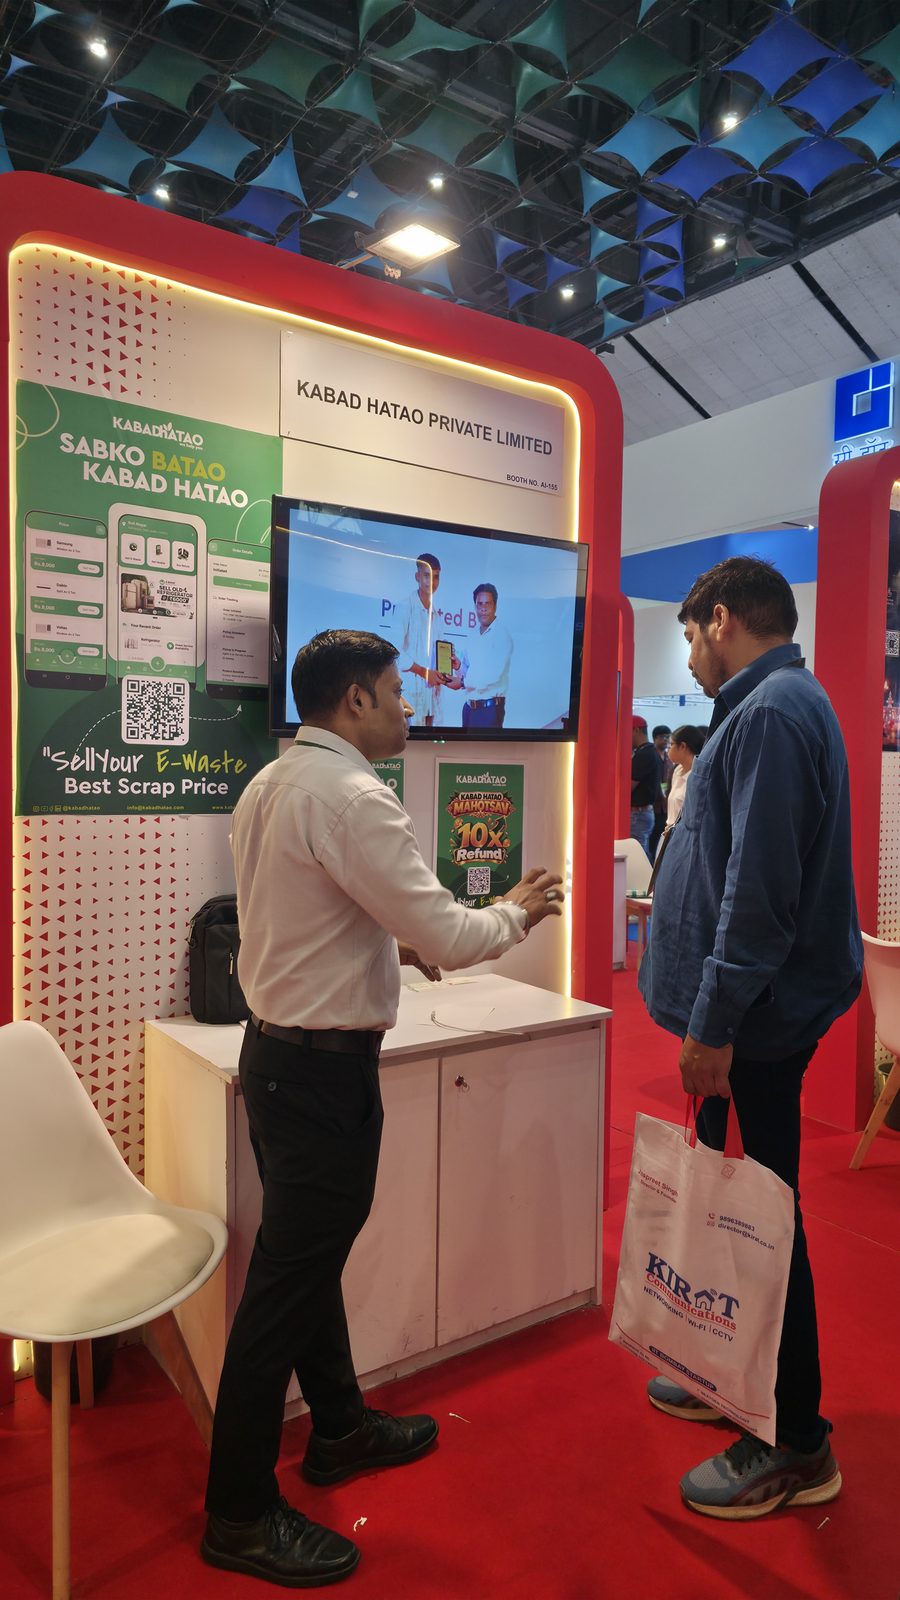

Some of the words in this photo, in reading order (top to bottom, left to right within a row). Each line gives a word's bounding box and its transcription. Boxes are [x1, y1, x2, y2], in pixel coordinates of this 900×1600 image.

[297, 379, 361, 410] KABAD
[367, 397, 423, 425] HATAO
[429, 412, 492, 442] PRIVATE
[497, 429, 552, 455] LIMITED
[60, 432, 145, 466] SABKO
[152, 451, 226, 482] BATAO
[83, 461, 167, 493] KABAD
[174, 478, 248, 508] HATAO
[506, 474, 528, 486] BOOTH
[529, 477, 539, 487] NO.
[157, 749, 247, 774] E-Waste
[64, 777, 111, 795] Best
[118, 778, 175, 798] Scrap
[181, 777, 229, 795] Price
[453, 801, 509, 816] MAHOTSAV
[457, 822, 505, 848] 10x
[456, 848, 502, 862] Refund
[643, 1286, 684, 1319] NETWORKING
[688, 1319, 706, 1332] WI-FI
[712, 1328, 734, 1342] CCTV
[646, 1273, 737, 1331] Communications
